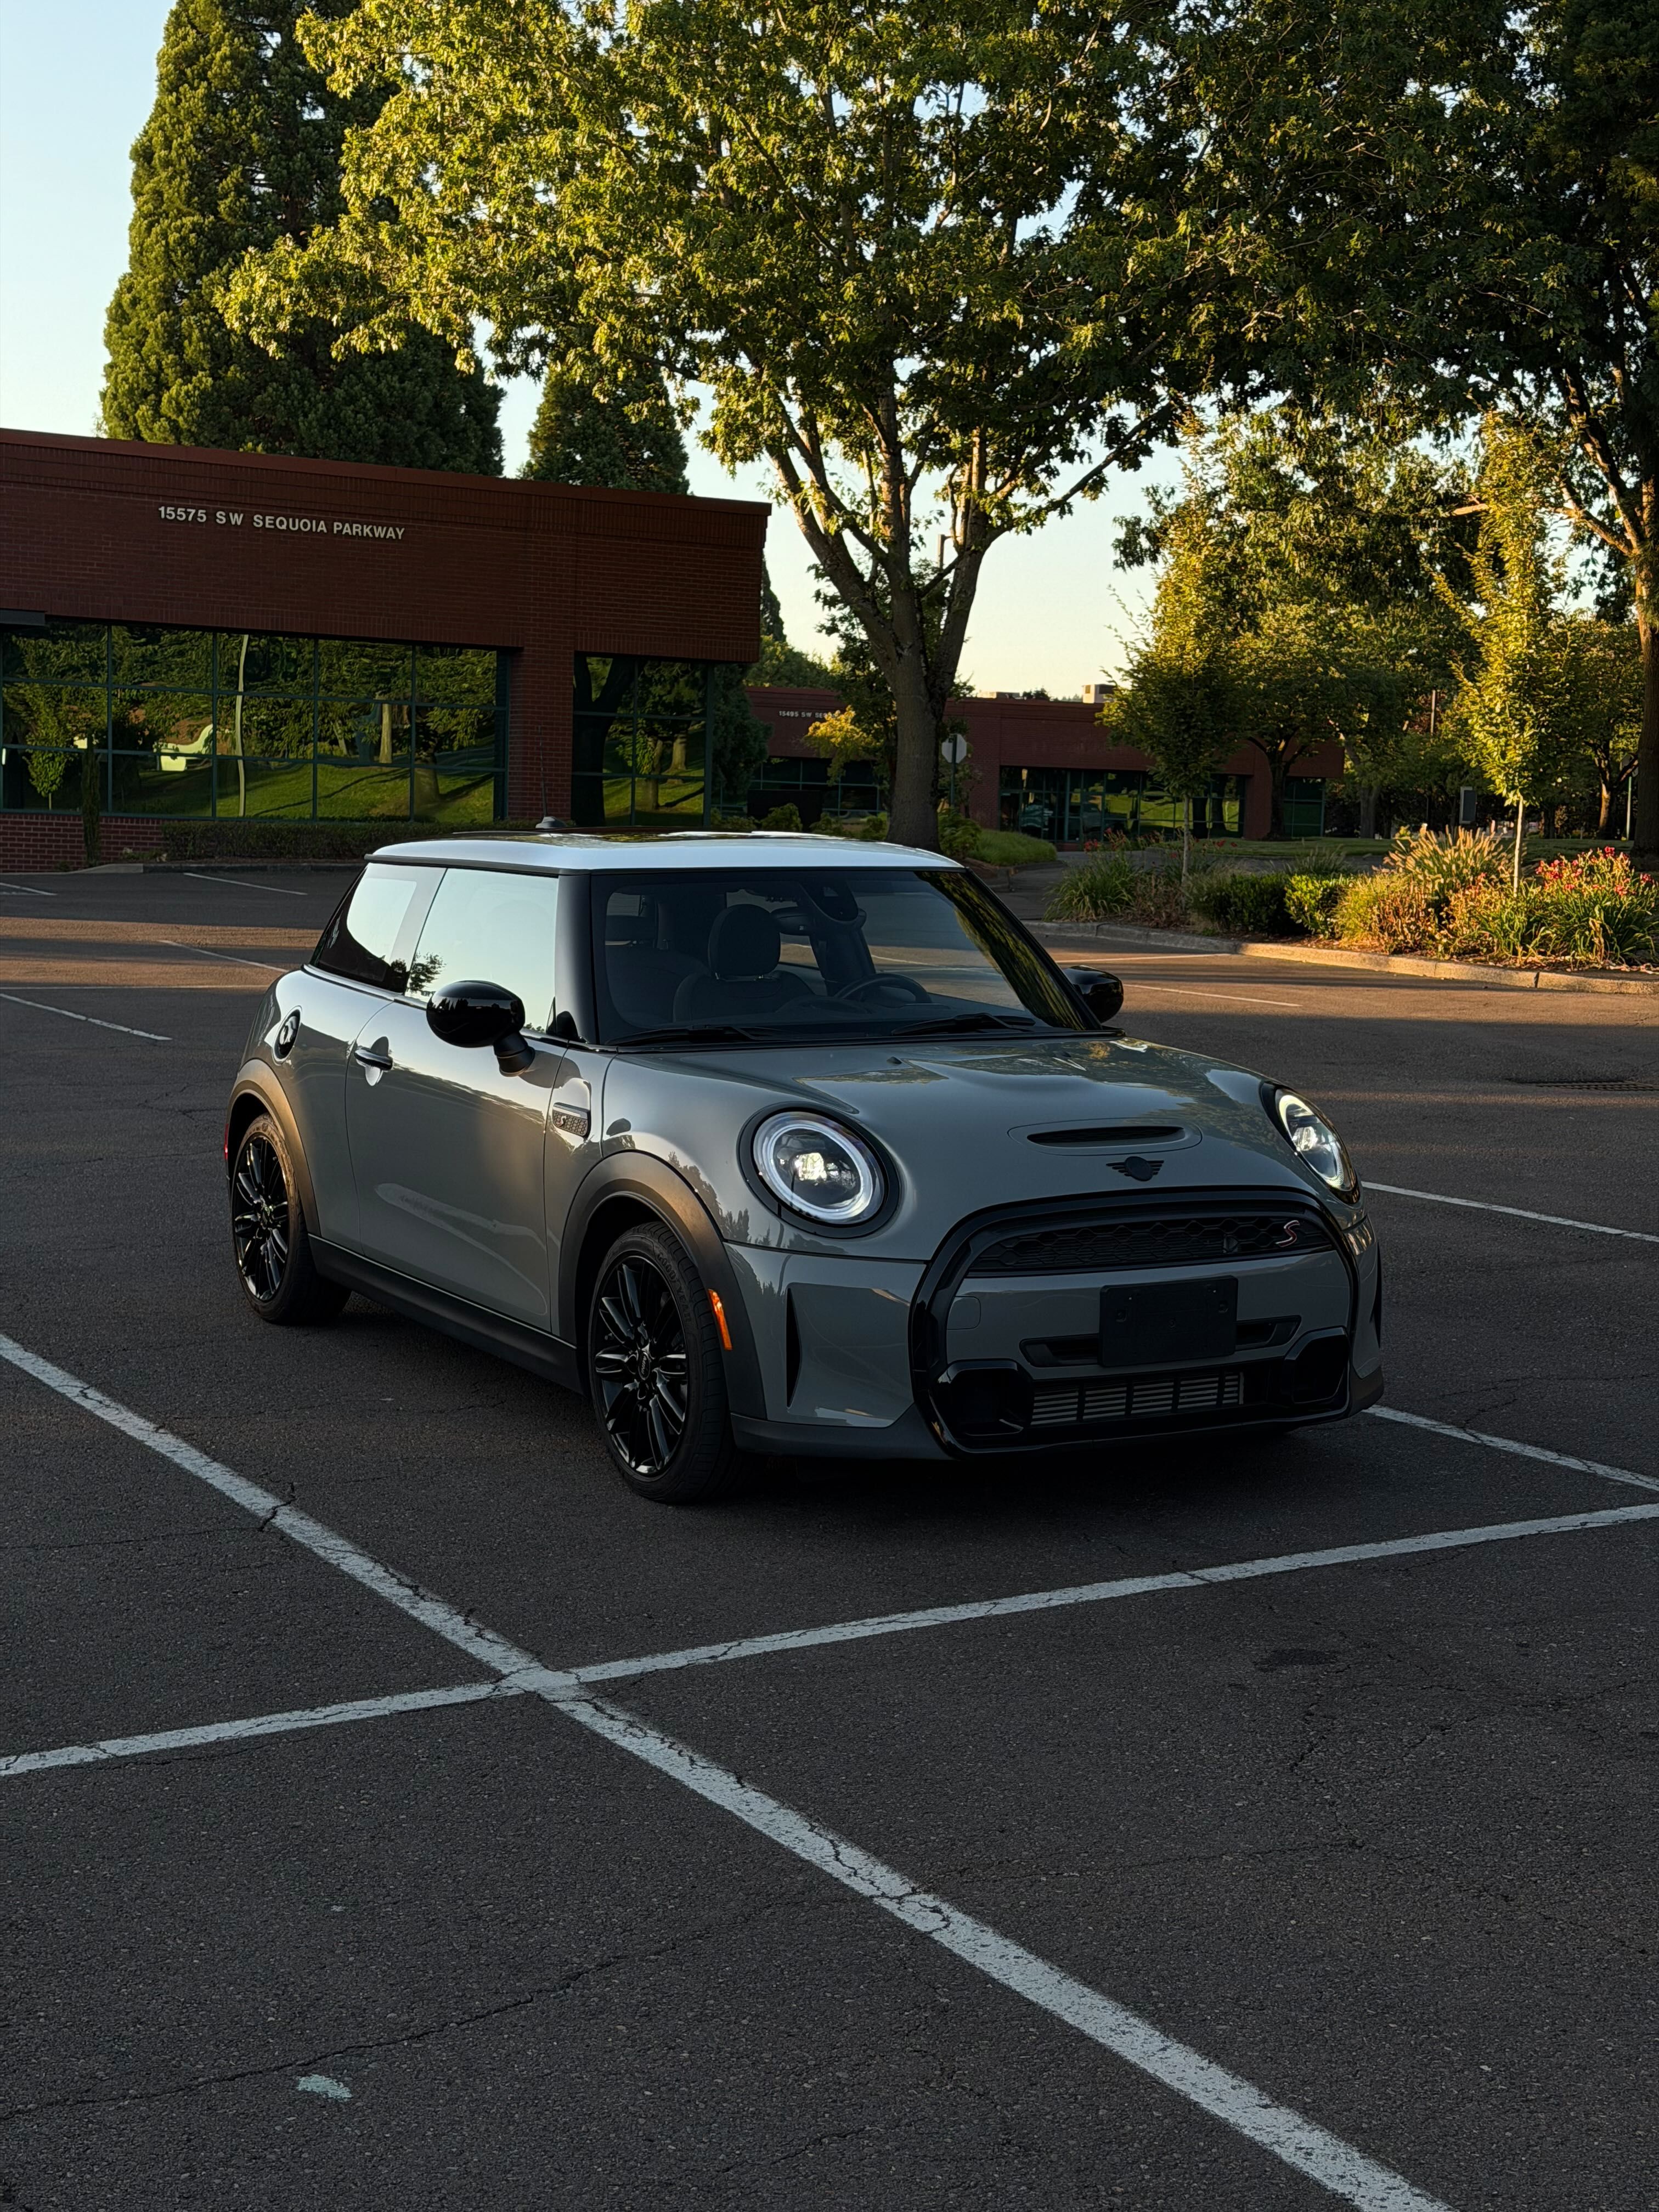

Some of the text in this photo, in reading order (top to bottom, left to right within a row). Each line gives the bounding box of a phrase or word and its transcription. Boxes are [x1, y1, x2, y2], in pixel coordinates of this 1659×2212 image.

[159, 506, 405, 539] 15575 SW SEQUOIA PARKWAY
[1275, 1220, 1300, 1248] S
